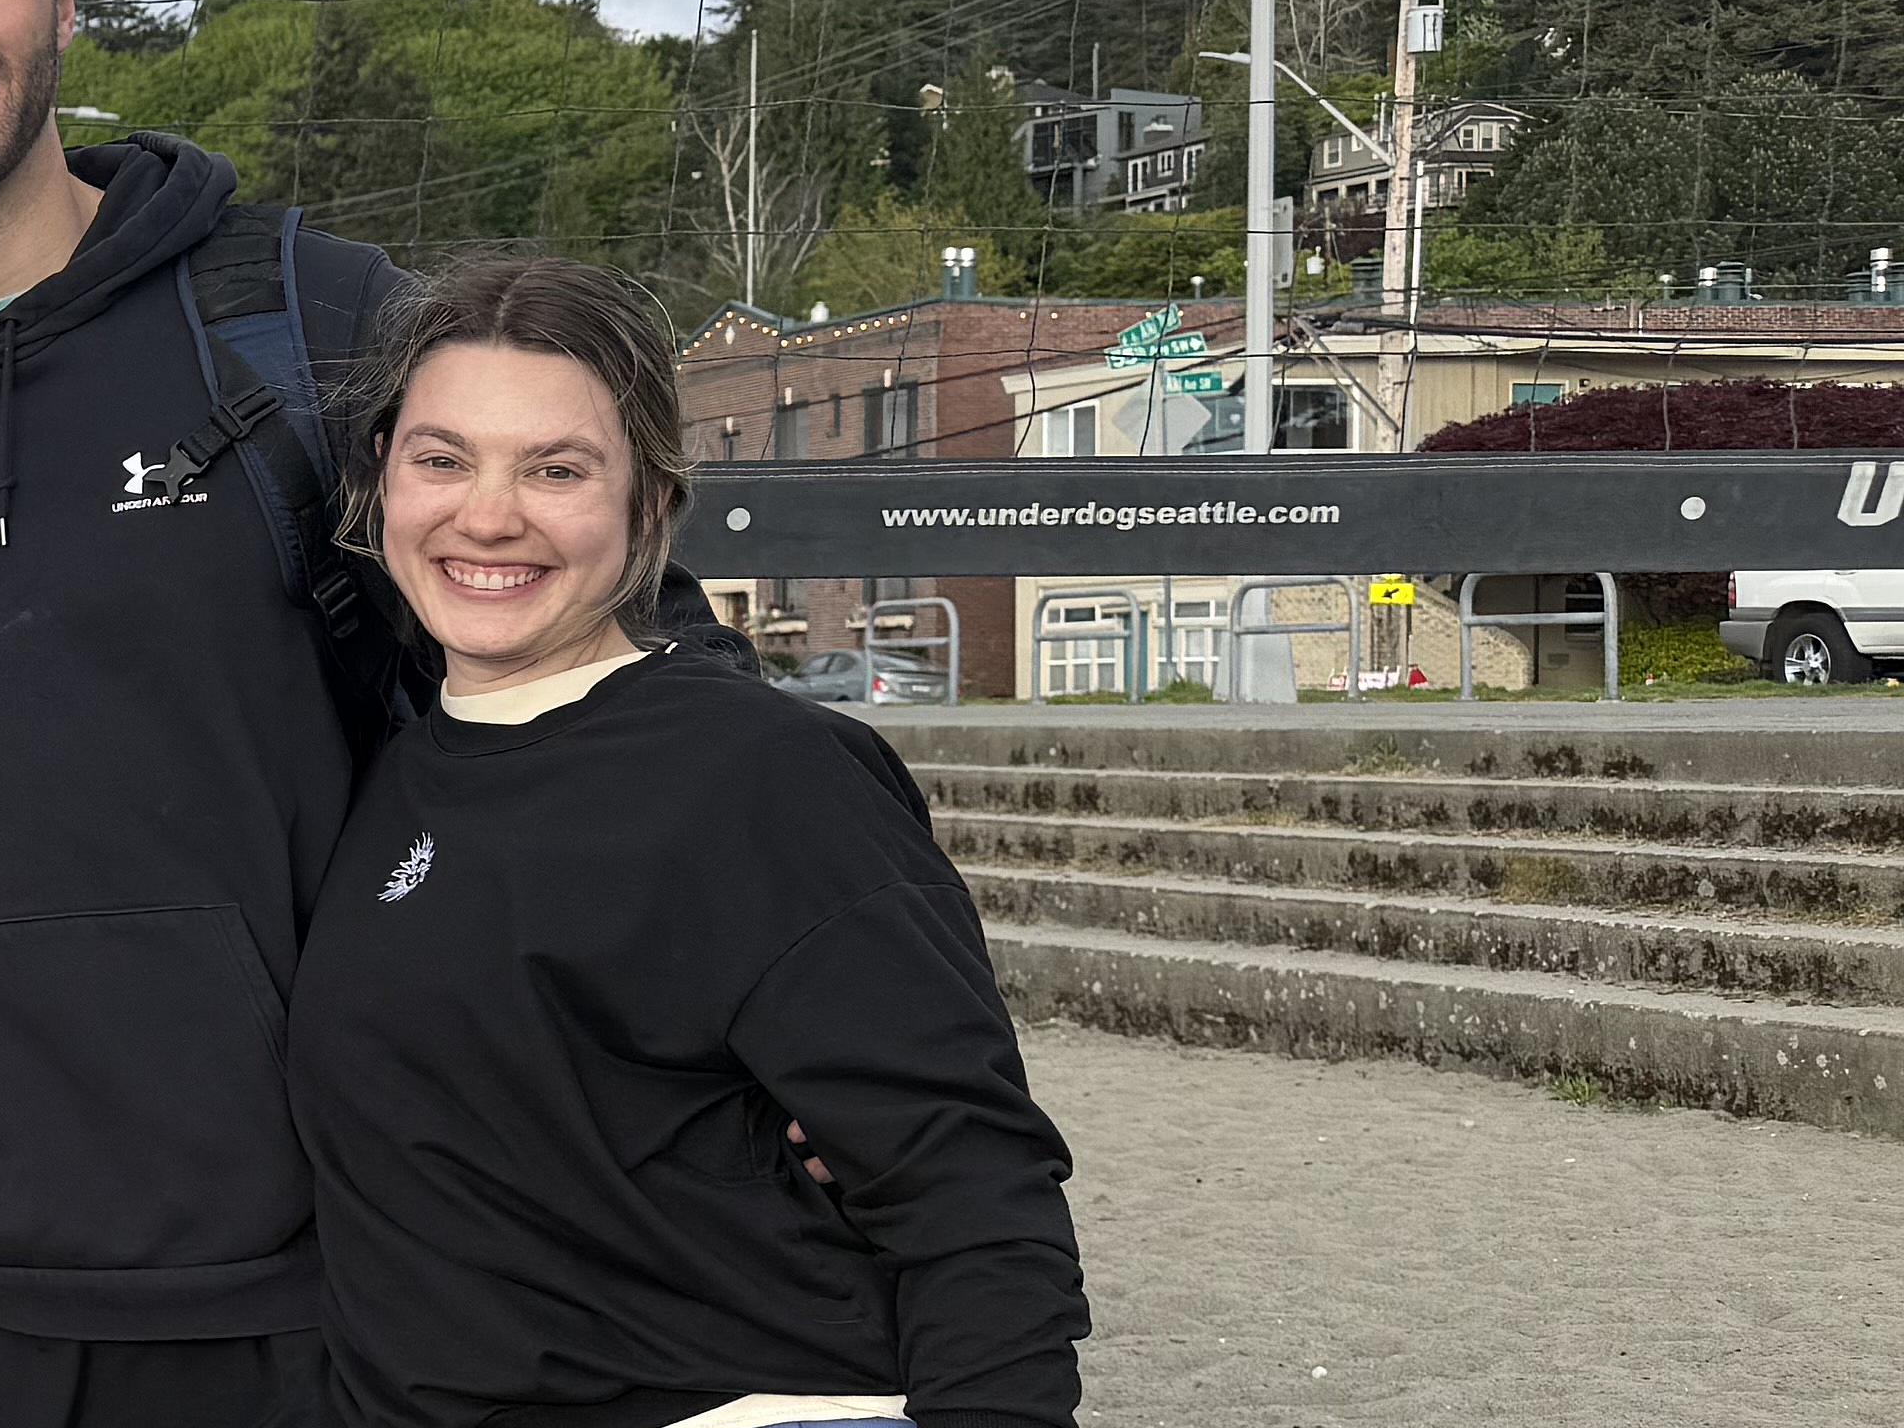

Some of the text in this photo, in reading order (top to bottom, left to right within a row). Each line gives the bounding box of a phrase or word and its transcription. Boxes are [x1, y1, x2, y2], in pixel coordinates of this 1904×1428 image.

[112, 493, 207, 512] UNDER AROUR
[881, 500, 1340, 531] www.underdogseattle.com
